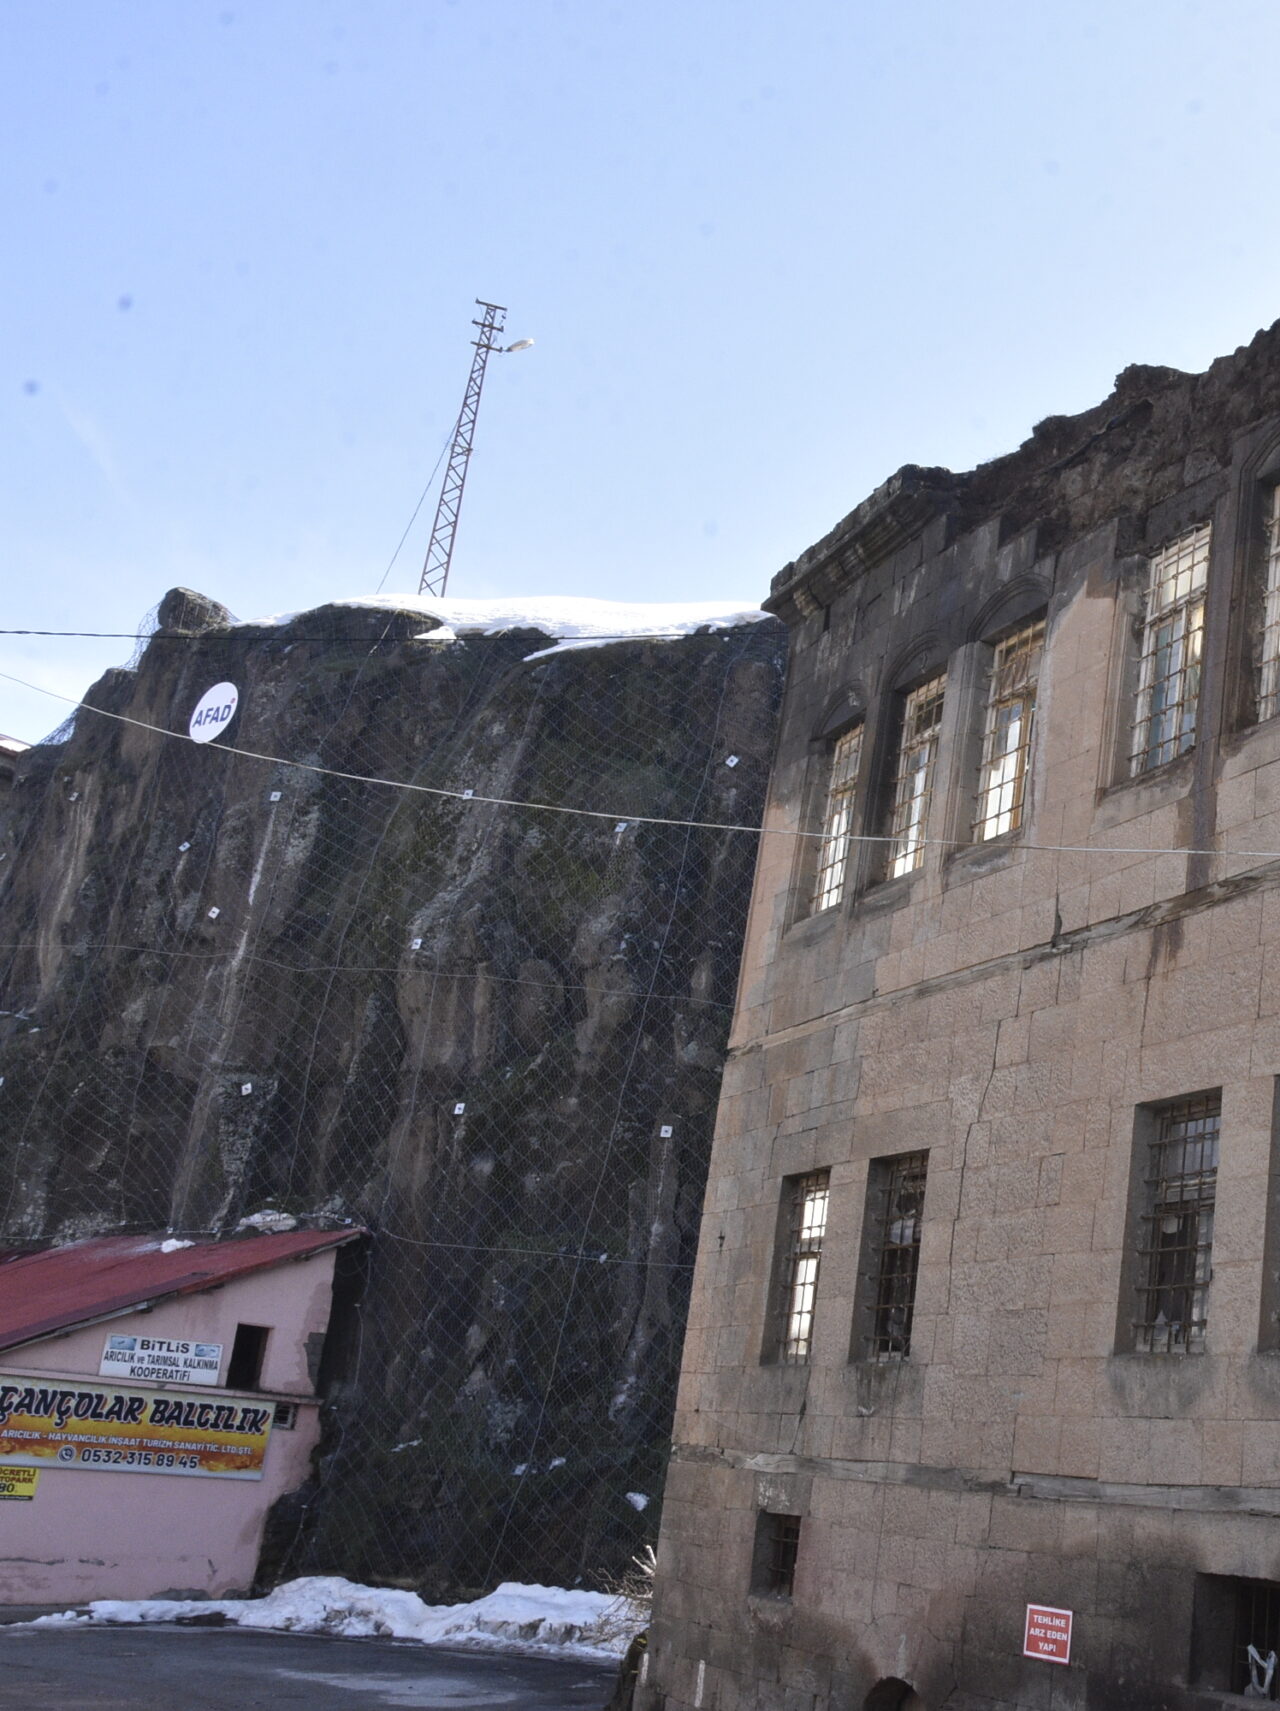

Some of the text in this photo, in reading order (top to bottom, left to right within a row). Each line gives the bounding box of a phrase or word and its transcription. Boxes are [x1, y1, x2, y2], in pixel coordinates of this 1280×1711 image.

[192, 704, 232, 728] AFAD
[104, 1350, 218, 1371] ARICILIK ve TARIMSAL KALKINMA
[0, 1386, 267, 1433] ÇANÇOLAR BALCILIK
[1, 1429, 41, 1440] ARICILIK
[48, 1432, 107, 1444] HAYVANCILIK
[81, 1449, 198, 1469] 0532 315 89 45
[1033, 1615, 1066, 1627] TEHLİKE
[1029, 1628, 1067, 1641] ARZ EDEN
[1038, 1641, 1056, 1652] YAPI
